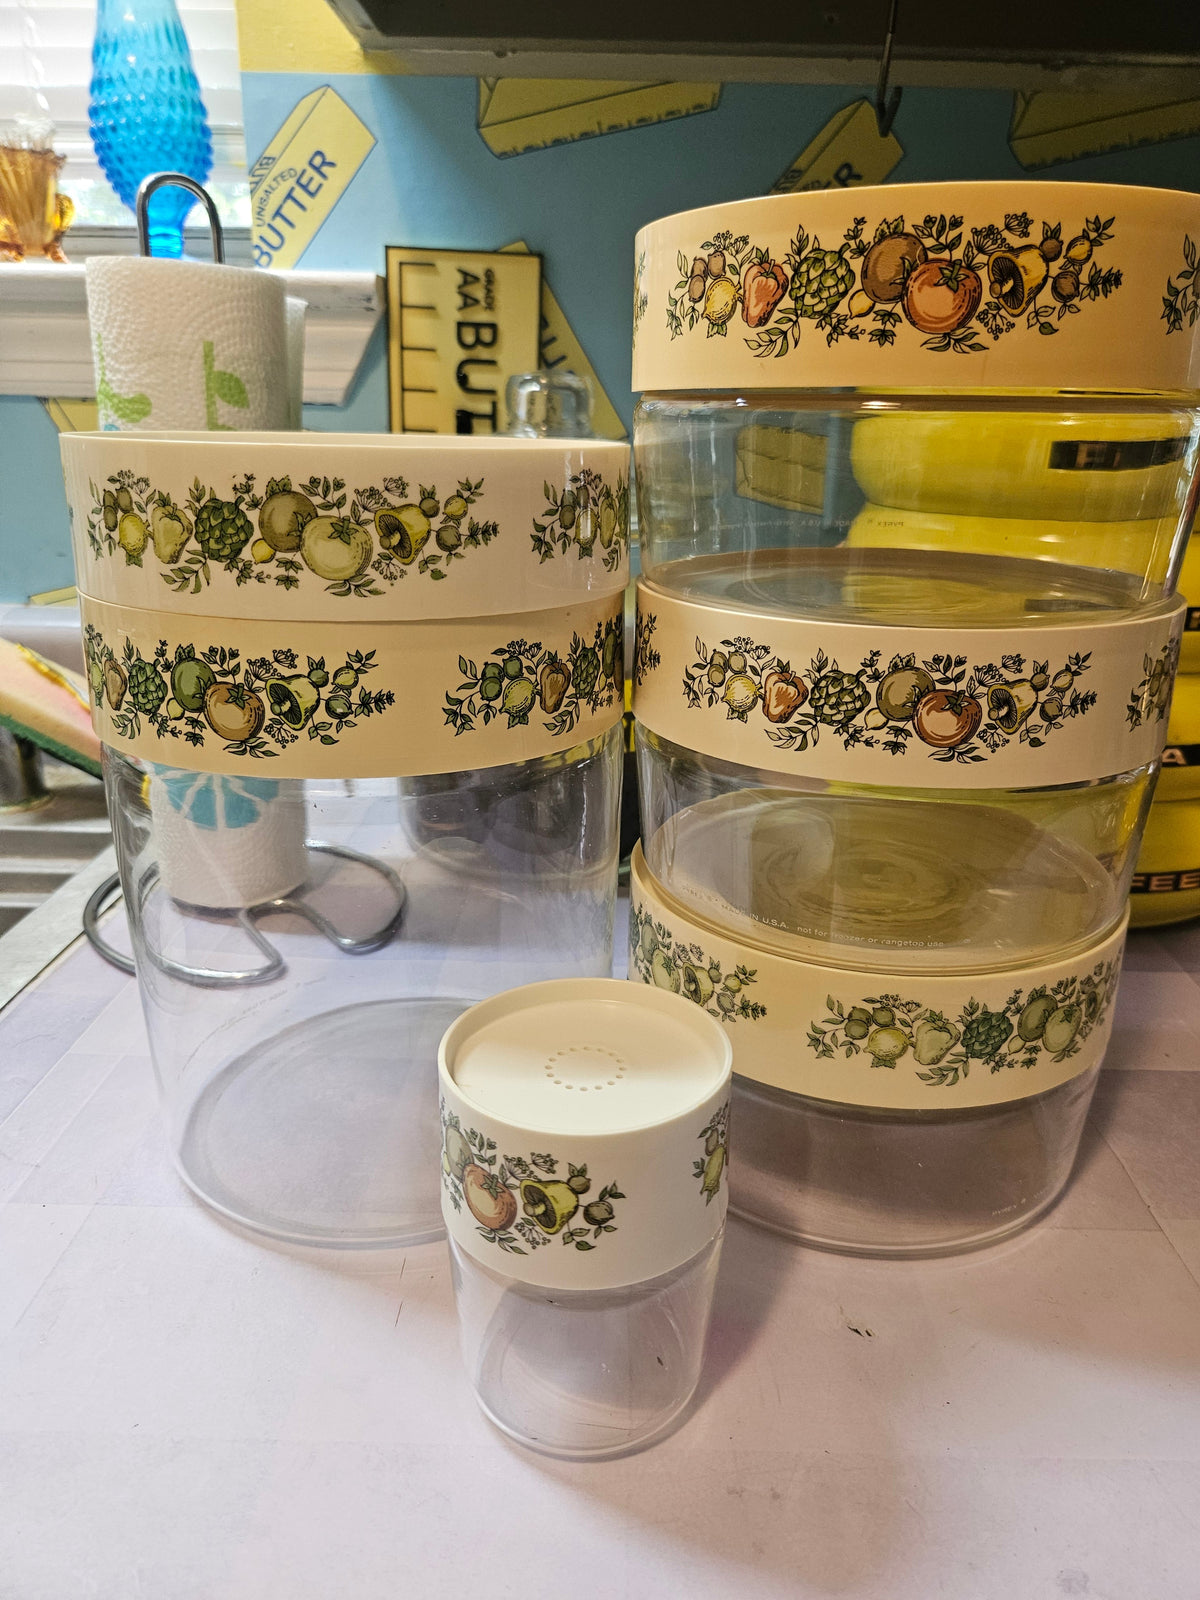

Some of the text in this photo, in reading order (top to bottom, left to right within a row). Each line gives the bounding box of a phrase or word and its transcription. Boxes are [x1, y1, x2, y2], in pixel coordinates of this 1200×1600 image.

[253, 150, 337, 268] BUTTER
[256, 167, 298, 227] UNSALTED
[456, 268, 481, 311] AA
[762, 917, 789, 929] U.S.A.
[797, 926, 812, 935] not
[814, 928, 827, 937] for
[867, 936, 878, 944] or
